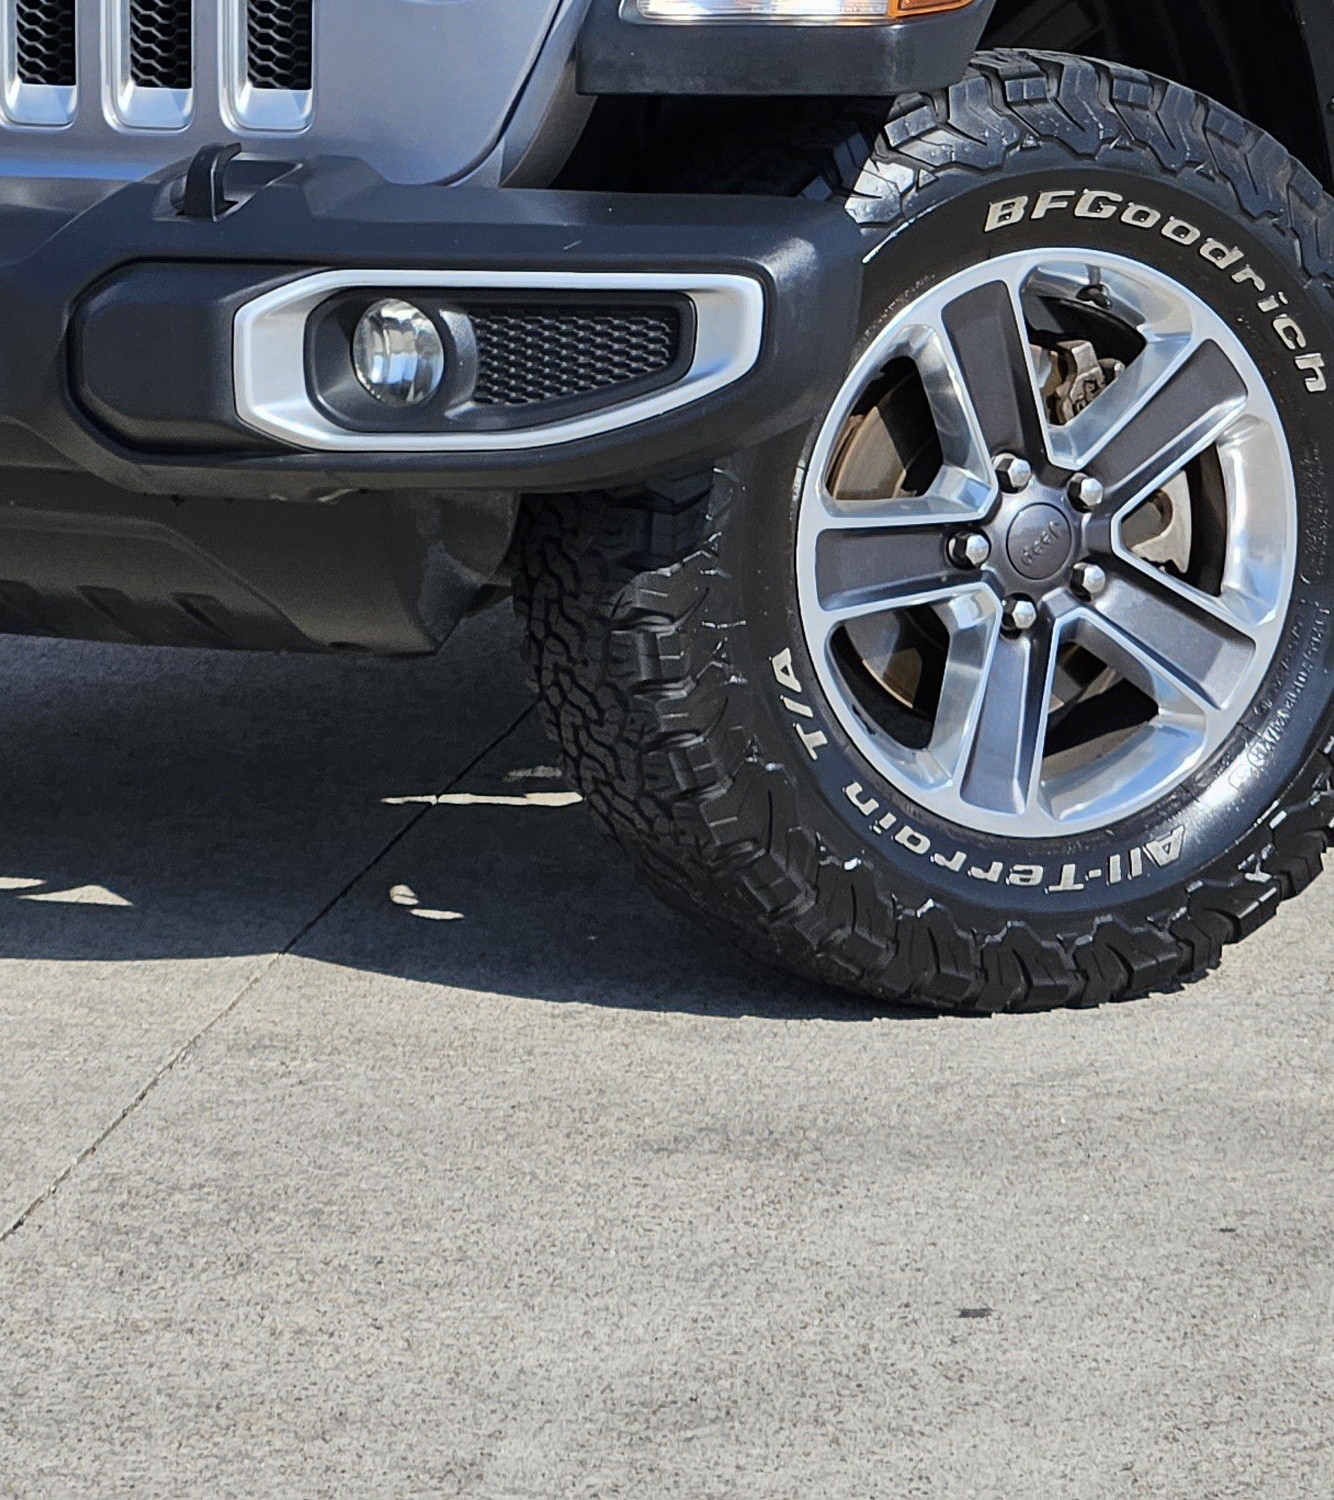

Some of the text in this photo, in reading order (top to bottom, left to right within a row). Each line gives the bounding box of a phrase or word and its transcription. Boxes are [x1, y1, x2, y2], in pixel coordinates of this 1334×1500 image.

[984, 189, 1327, 393] BFGoodrich
[1021, 521, 1063, 567] Jeep
[769, 647, 1186, 895] All-Terrain T/A
